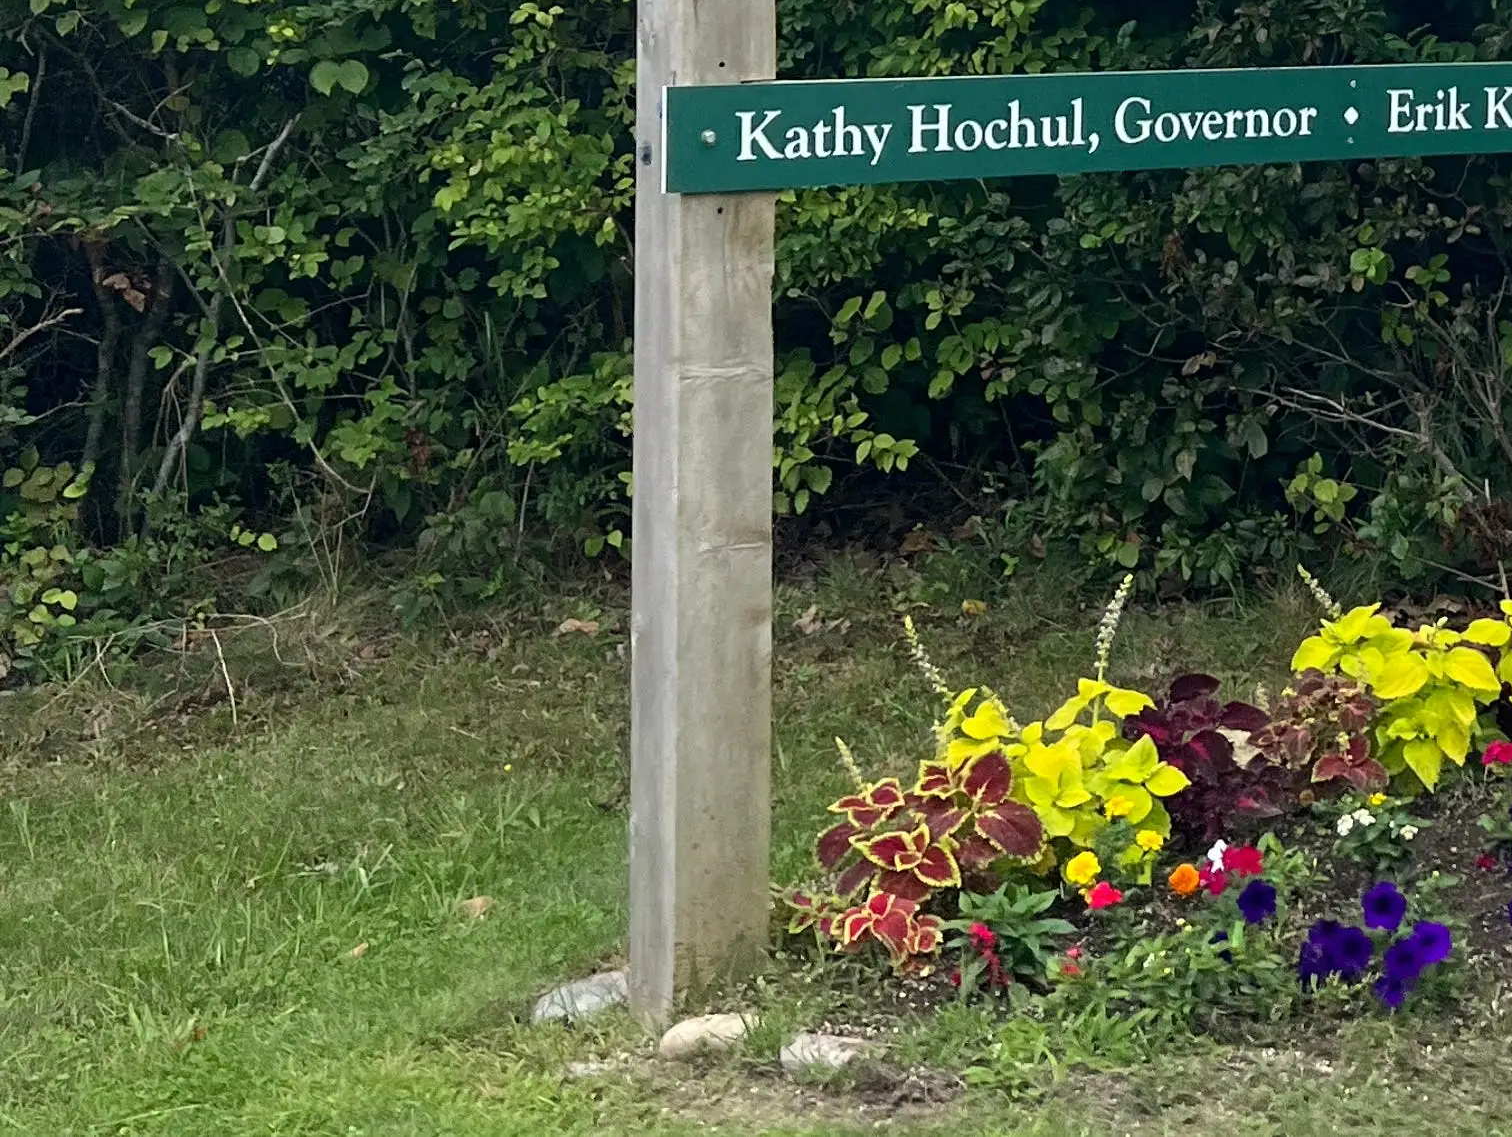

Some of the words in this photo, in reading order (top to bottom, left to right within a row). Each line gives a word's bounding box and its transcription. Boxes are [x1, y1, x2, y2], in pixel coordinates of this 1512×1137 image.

[735, 107, 893, 166] Kathy
[906, 97, 1101, 155] Hochul,
[1114, 96, 1318, 144] Governor
[1386, 84, 1473, 133] Erik
